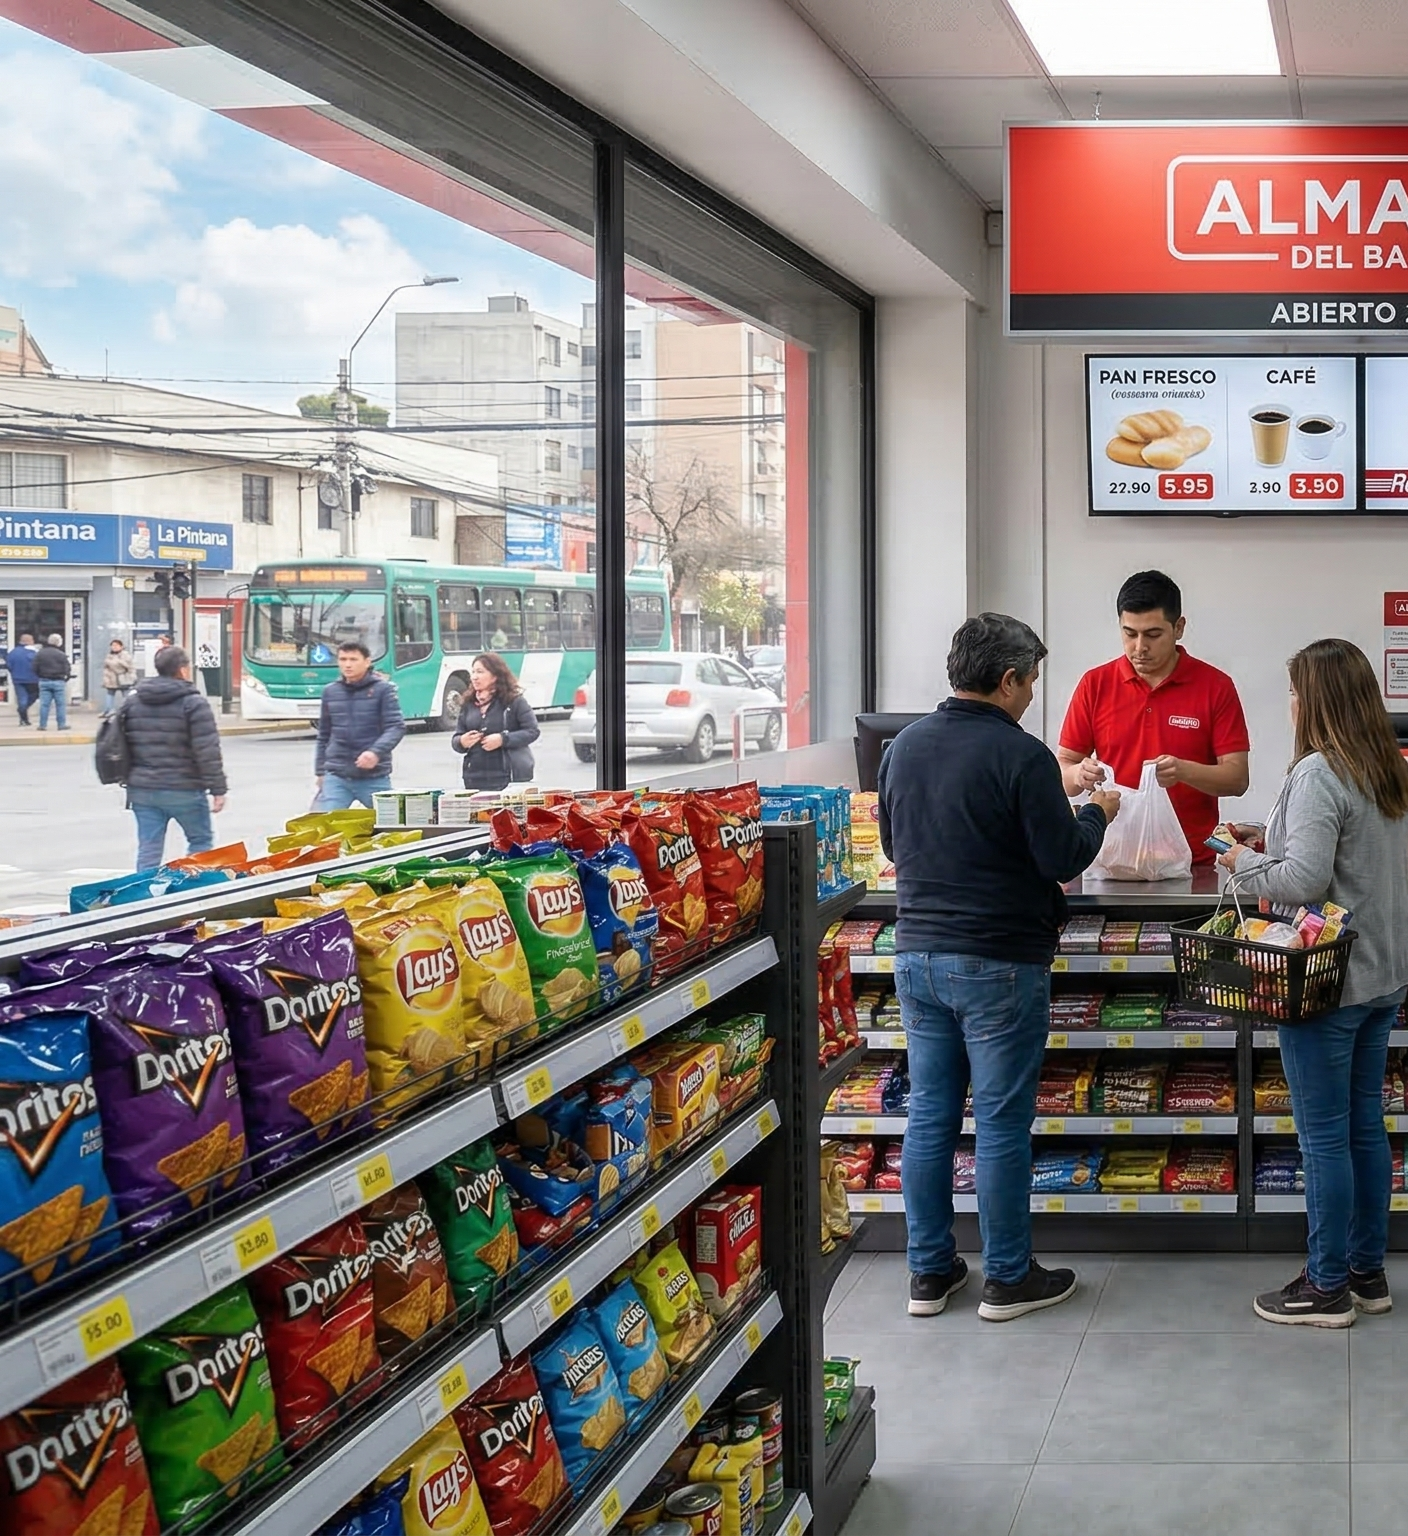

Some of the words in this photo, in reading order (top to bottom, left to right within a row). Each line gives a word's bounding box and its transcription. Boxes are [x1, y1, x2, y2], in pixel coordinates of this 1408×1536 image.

[1290, 244, 1357, 271] DEL
[1270, 302, 1396, 324] ABIERTO
[1099, 370, 1137, 385] PAN
[1143, 370, 1217, 385] FRESCO
[1266, 366, 1317, 384] CAFÉ
[1164, 477, 1209, 495] 5.95
[0, 517, 97, 541] intana
[157, 523, 174, 543] La
[177, 526, 229, 547] Pintana
[531, 882, 581, 924] Lay's
[462, 909, 515, 961] Lay's
[403, 940, 460, 999] Lay's
[265, 974, 363, 1031] Doritos
[423, 1453, 472, 1522] Lay's
